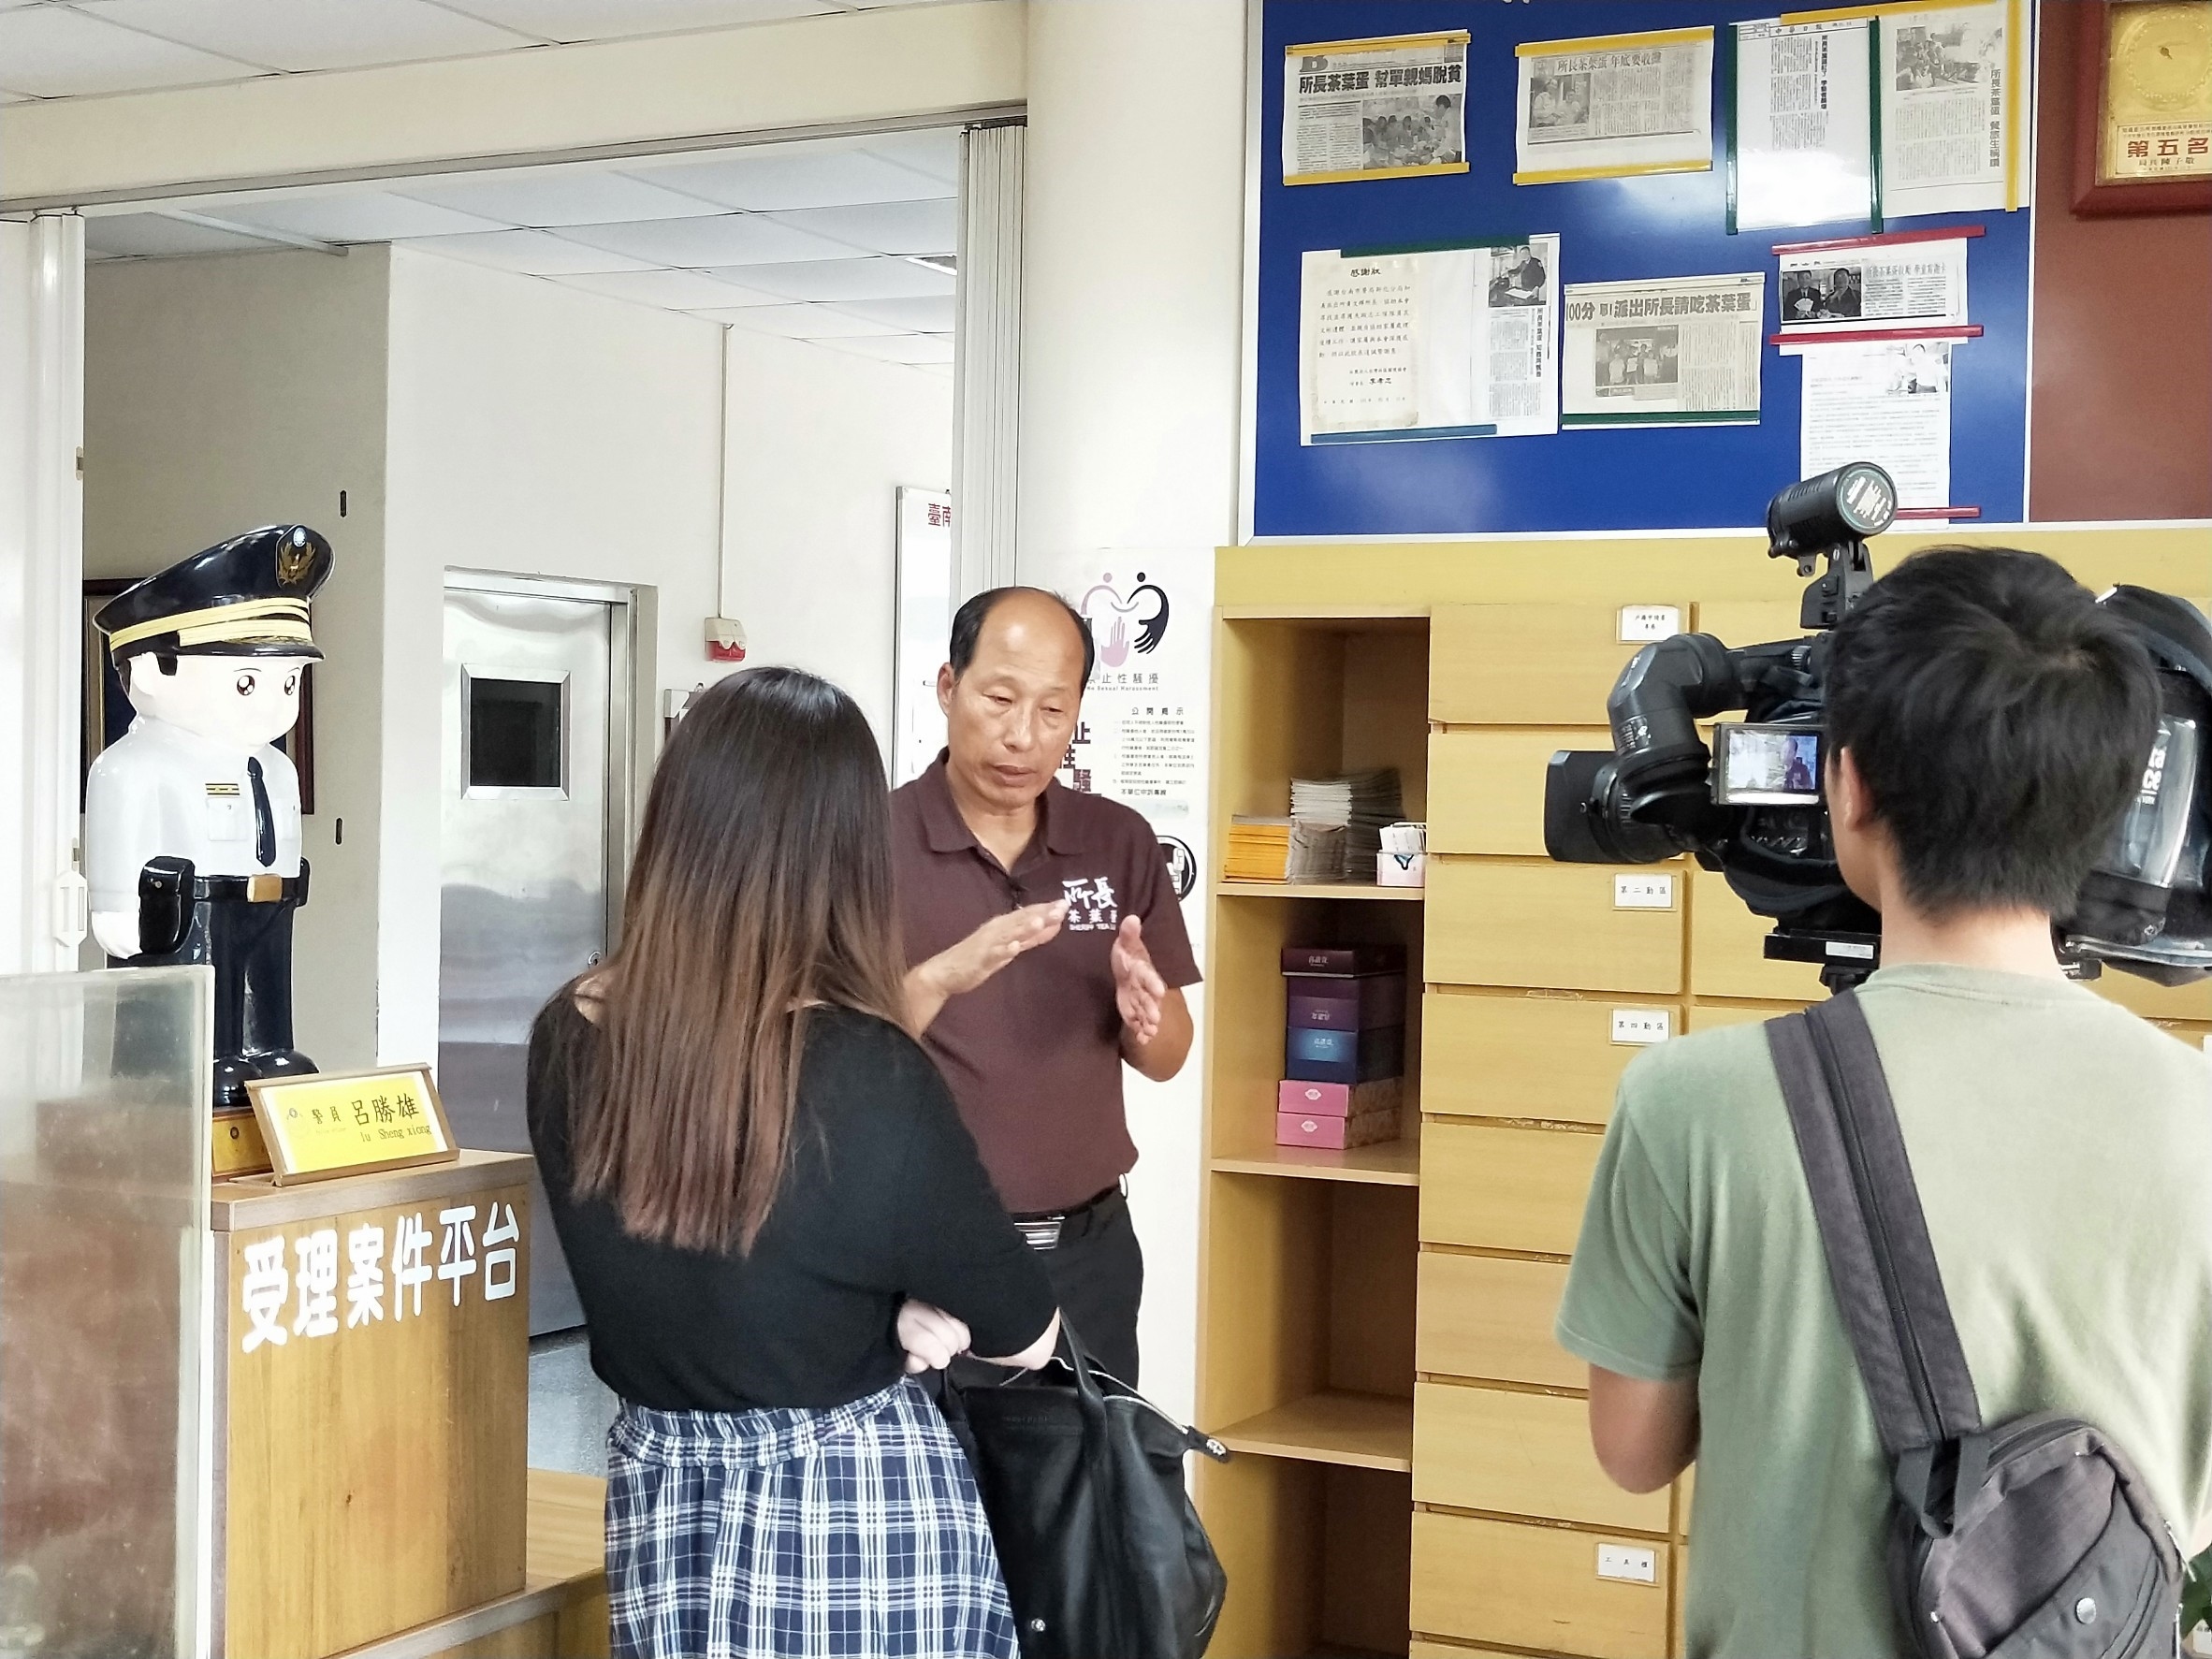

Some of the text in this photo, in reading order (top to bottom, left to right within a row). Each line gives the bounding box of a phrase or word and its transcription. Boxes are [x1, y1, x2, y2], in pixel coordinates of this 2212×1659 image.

[1299, 71, 1369, 94] 所長茶葉蛋
[2128, 138, 2208, 158] 第五名
[1350, 268, 1381, 277] 感謝狀
[1062, 876, 1118, 910] 所長
[352, 1093, 420, 1126] 呂勝雄
[378, 1128, 404, 1140] Sheng
[408, 1125, 431, 1137] xiong
[241, 1201, 520, 1354] 受理案件平台
